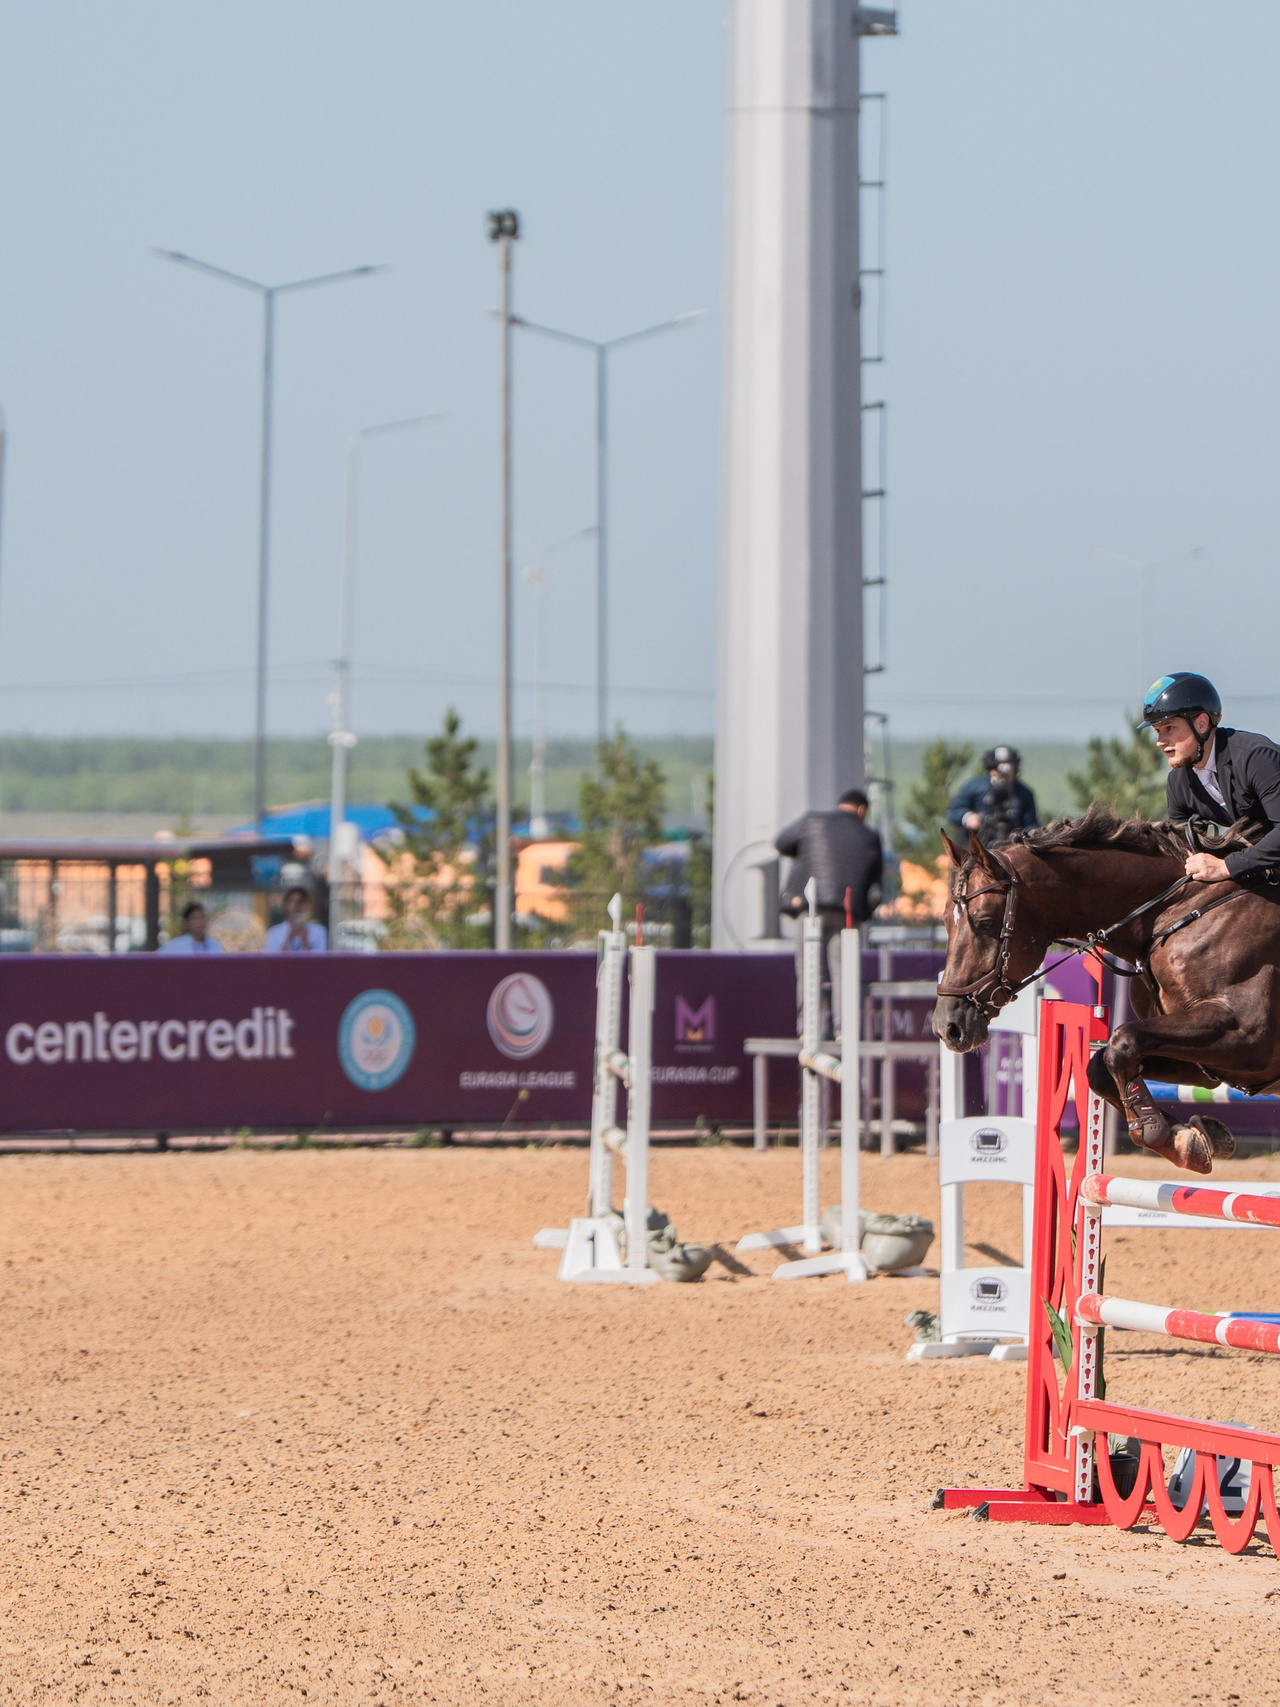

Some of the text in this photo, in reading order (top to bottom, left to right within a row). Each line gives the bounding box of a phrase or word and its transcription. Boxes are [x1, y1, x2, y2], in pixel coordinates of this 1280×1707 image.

[5, 1006, 295, 1065] centercredit
[459, 1071, 576, 1089] EURASIA LEAGUE
[651, 1065, 740, 1084] EURASIA CUP
[586, 1230, 597, 1268] 1
